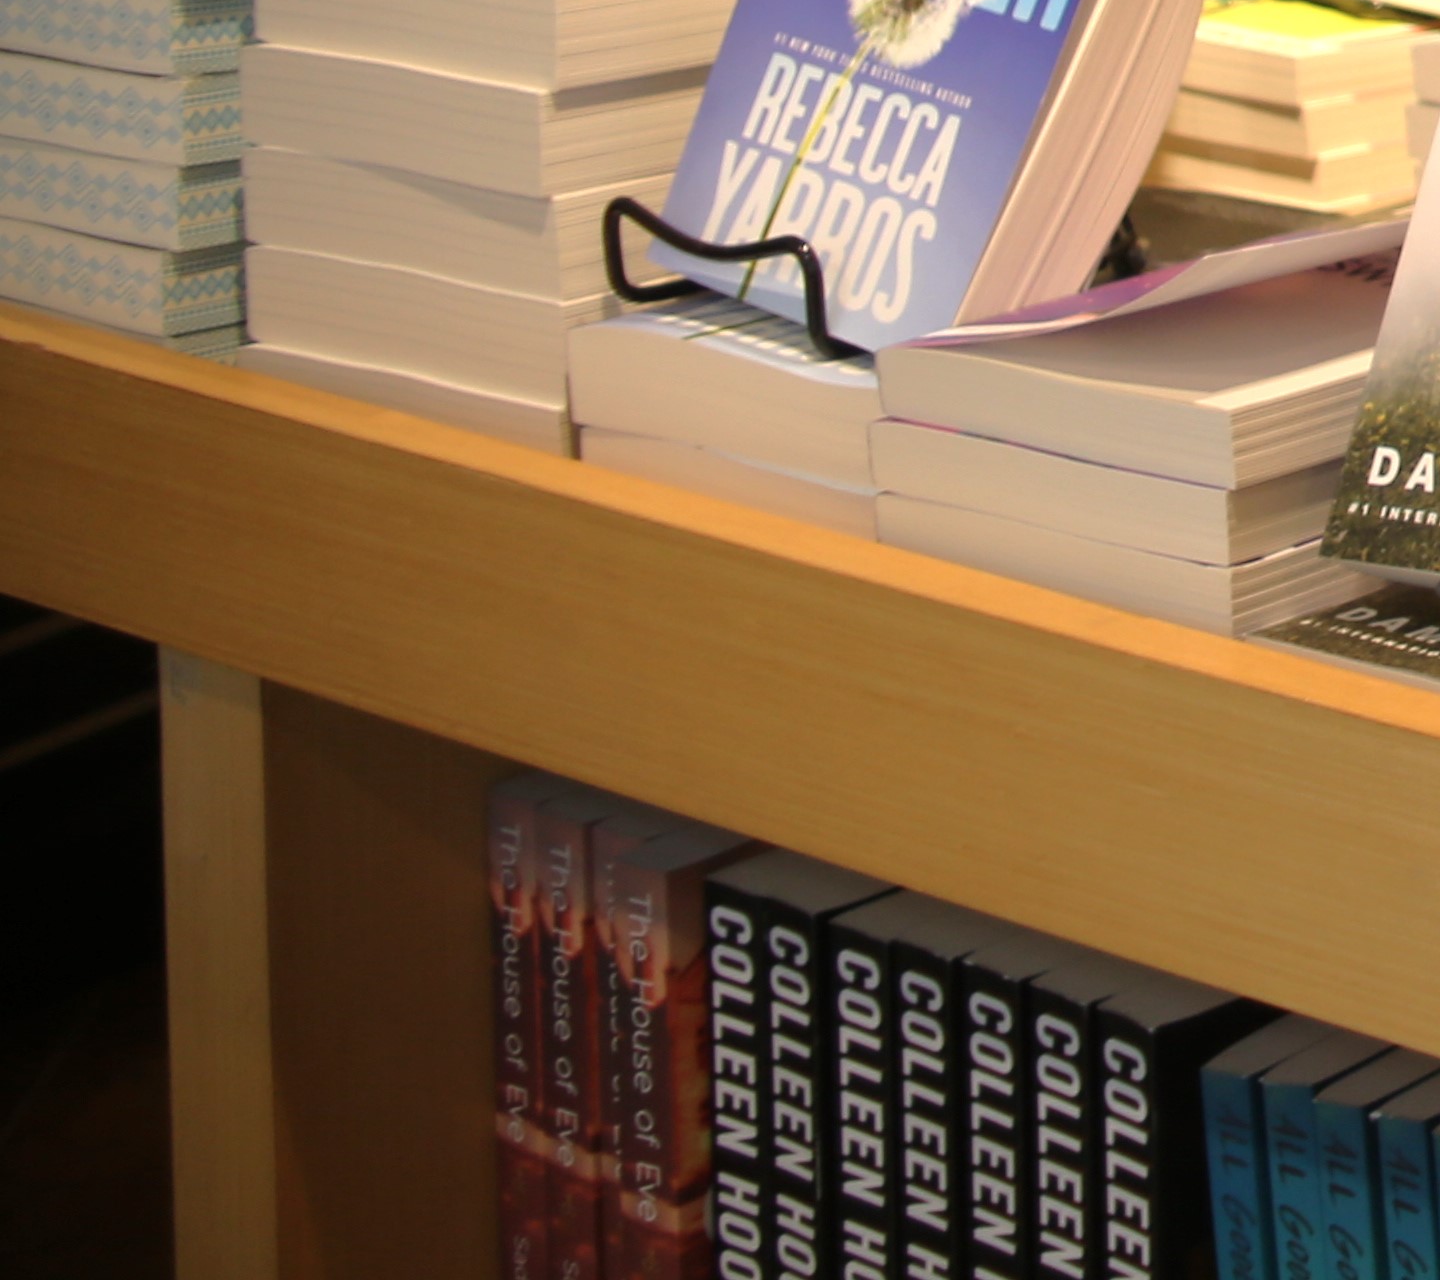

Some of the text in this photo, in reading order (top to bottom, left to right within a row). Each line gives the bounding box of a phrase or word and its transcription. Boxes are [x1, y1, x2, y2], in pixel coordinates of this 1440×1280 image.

[701, 140, 938, 324] YARROS
[742, 53, 962, 208] REBECCA
[499, 825, 529, 1143] The House Eve
[549, 845, 579, 1168] The House of Eve
[629, 893, 662, 1224] The House of Eve
[709, 905, 759, 1160] COLLEEN
[768, 925, 814, 1184] COLLEEN
[836, 948, 886, 1209] COLLEEN
[899, 969, 949, 1233] COLLEEN
[968, 990, 1017, 1257] COLLEEN
[1035, 1012, 1085, 1280] COLLEEN
